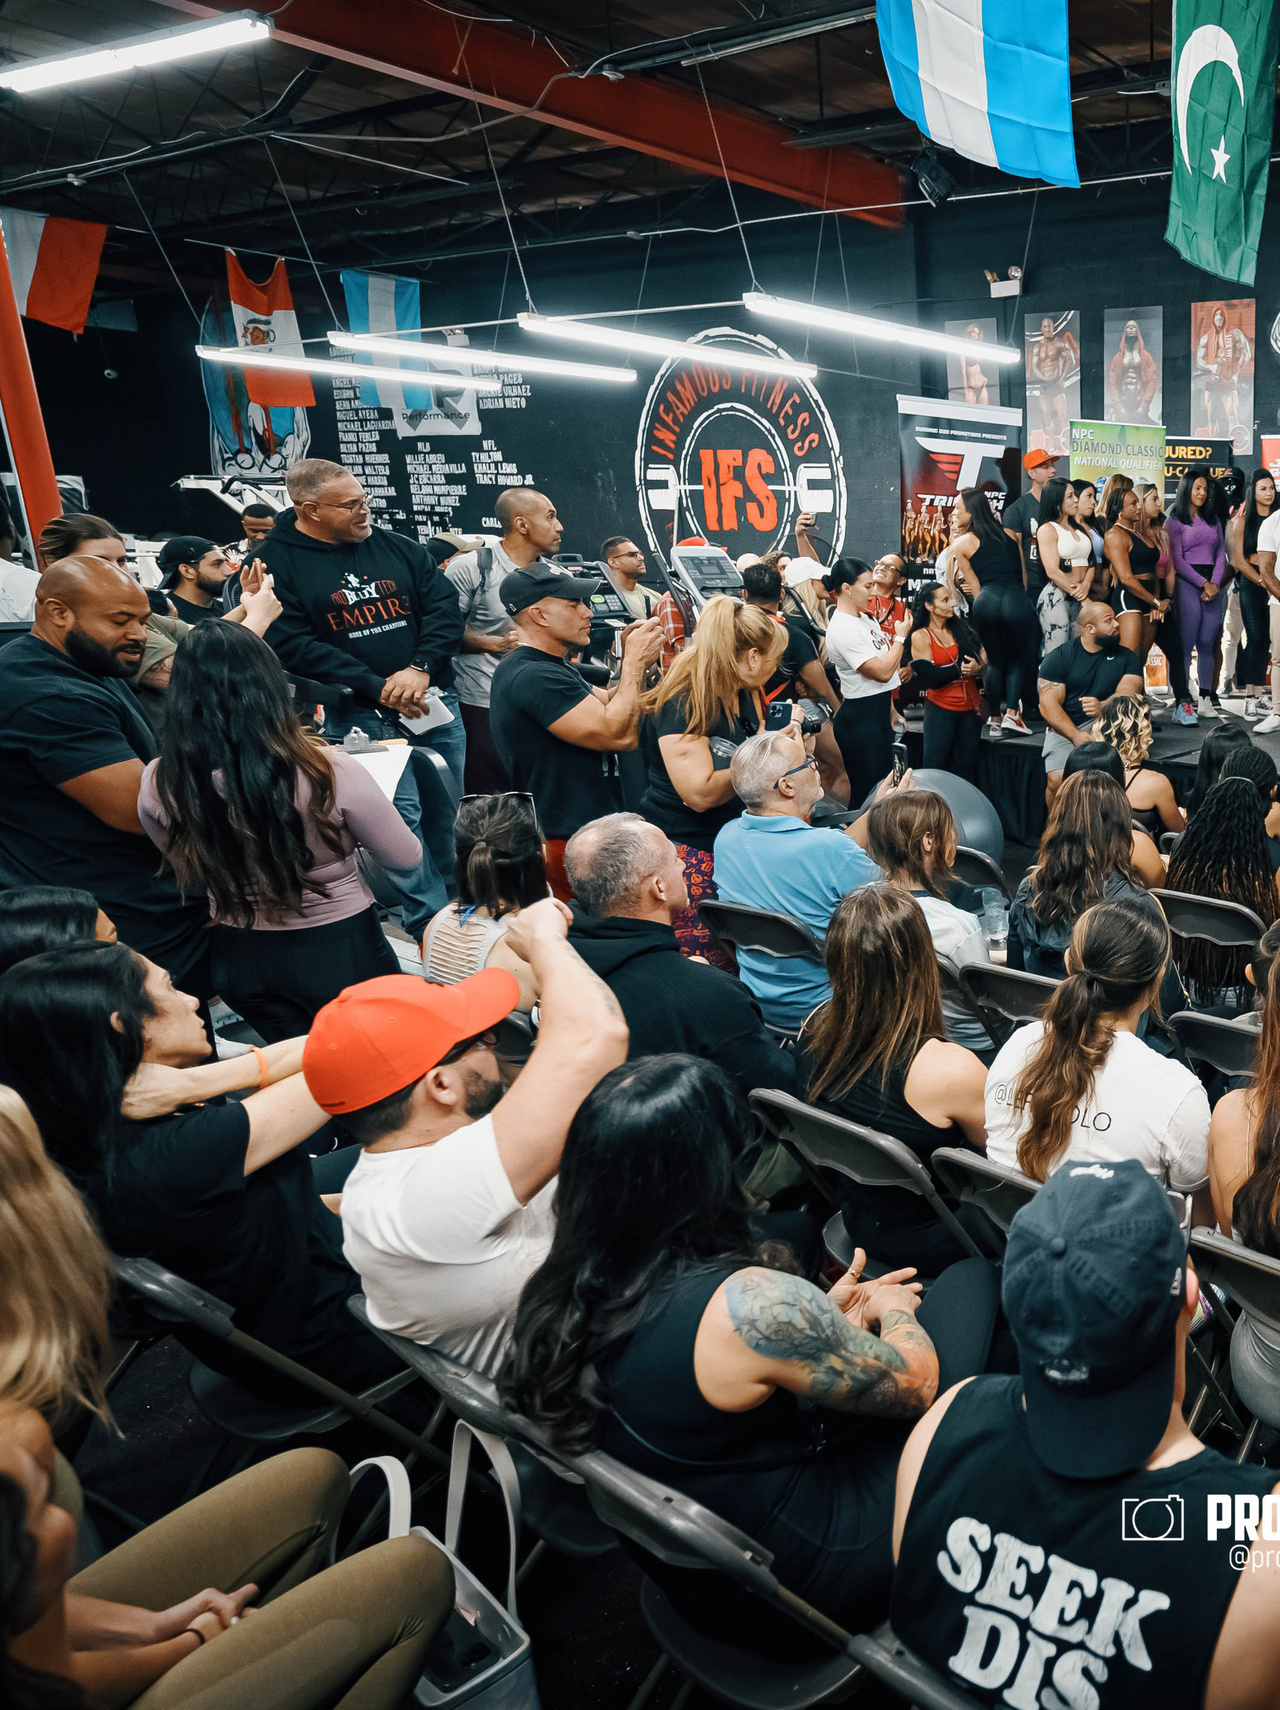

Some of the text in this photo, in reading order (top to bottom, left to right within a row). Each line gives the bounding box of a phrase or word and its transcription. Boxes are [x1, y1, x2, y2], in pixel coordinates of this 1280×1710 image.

[479, 398, 527, 409] ADRIAN NIETO
[402, 411, 470, 421] Performance
[651, 361, 820, 460] INFAMOUS FITNESS
[1072, 428, 1094, 440] NPC
[417, 442, 431, 452] MLB
[482, 440, 497, 451] NFL
[1072, 440, 1165, 458] DIAMOND CLASSIC
[1165, 446, 1212, 460] JURED?
[1073, 456, 1163, 471] NATIONAL QUALIFIER
[475, 474, 496, 485] TRACY
[497, 474, 523, 486] HOWARD
[699, 448, 778, 532] IFS
[412, 495, 439, 505] ANTHONY
[937, 1516, 1171, 1671] SEEK
